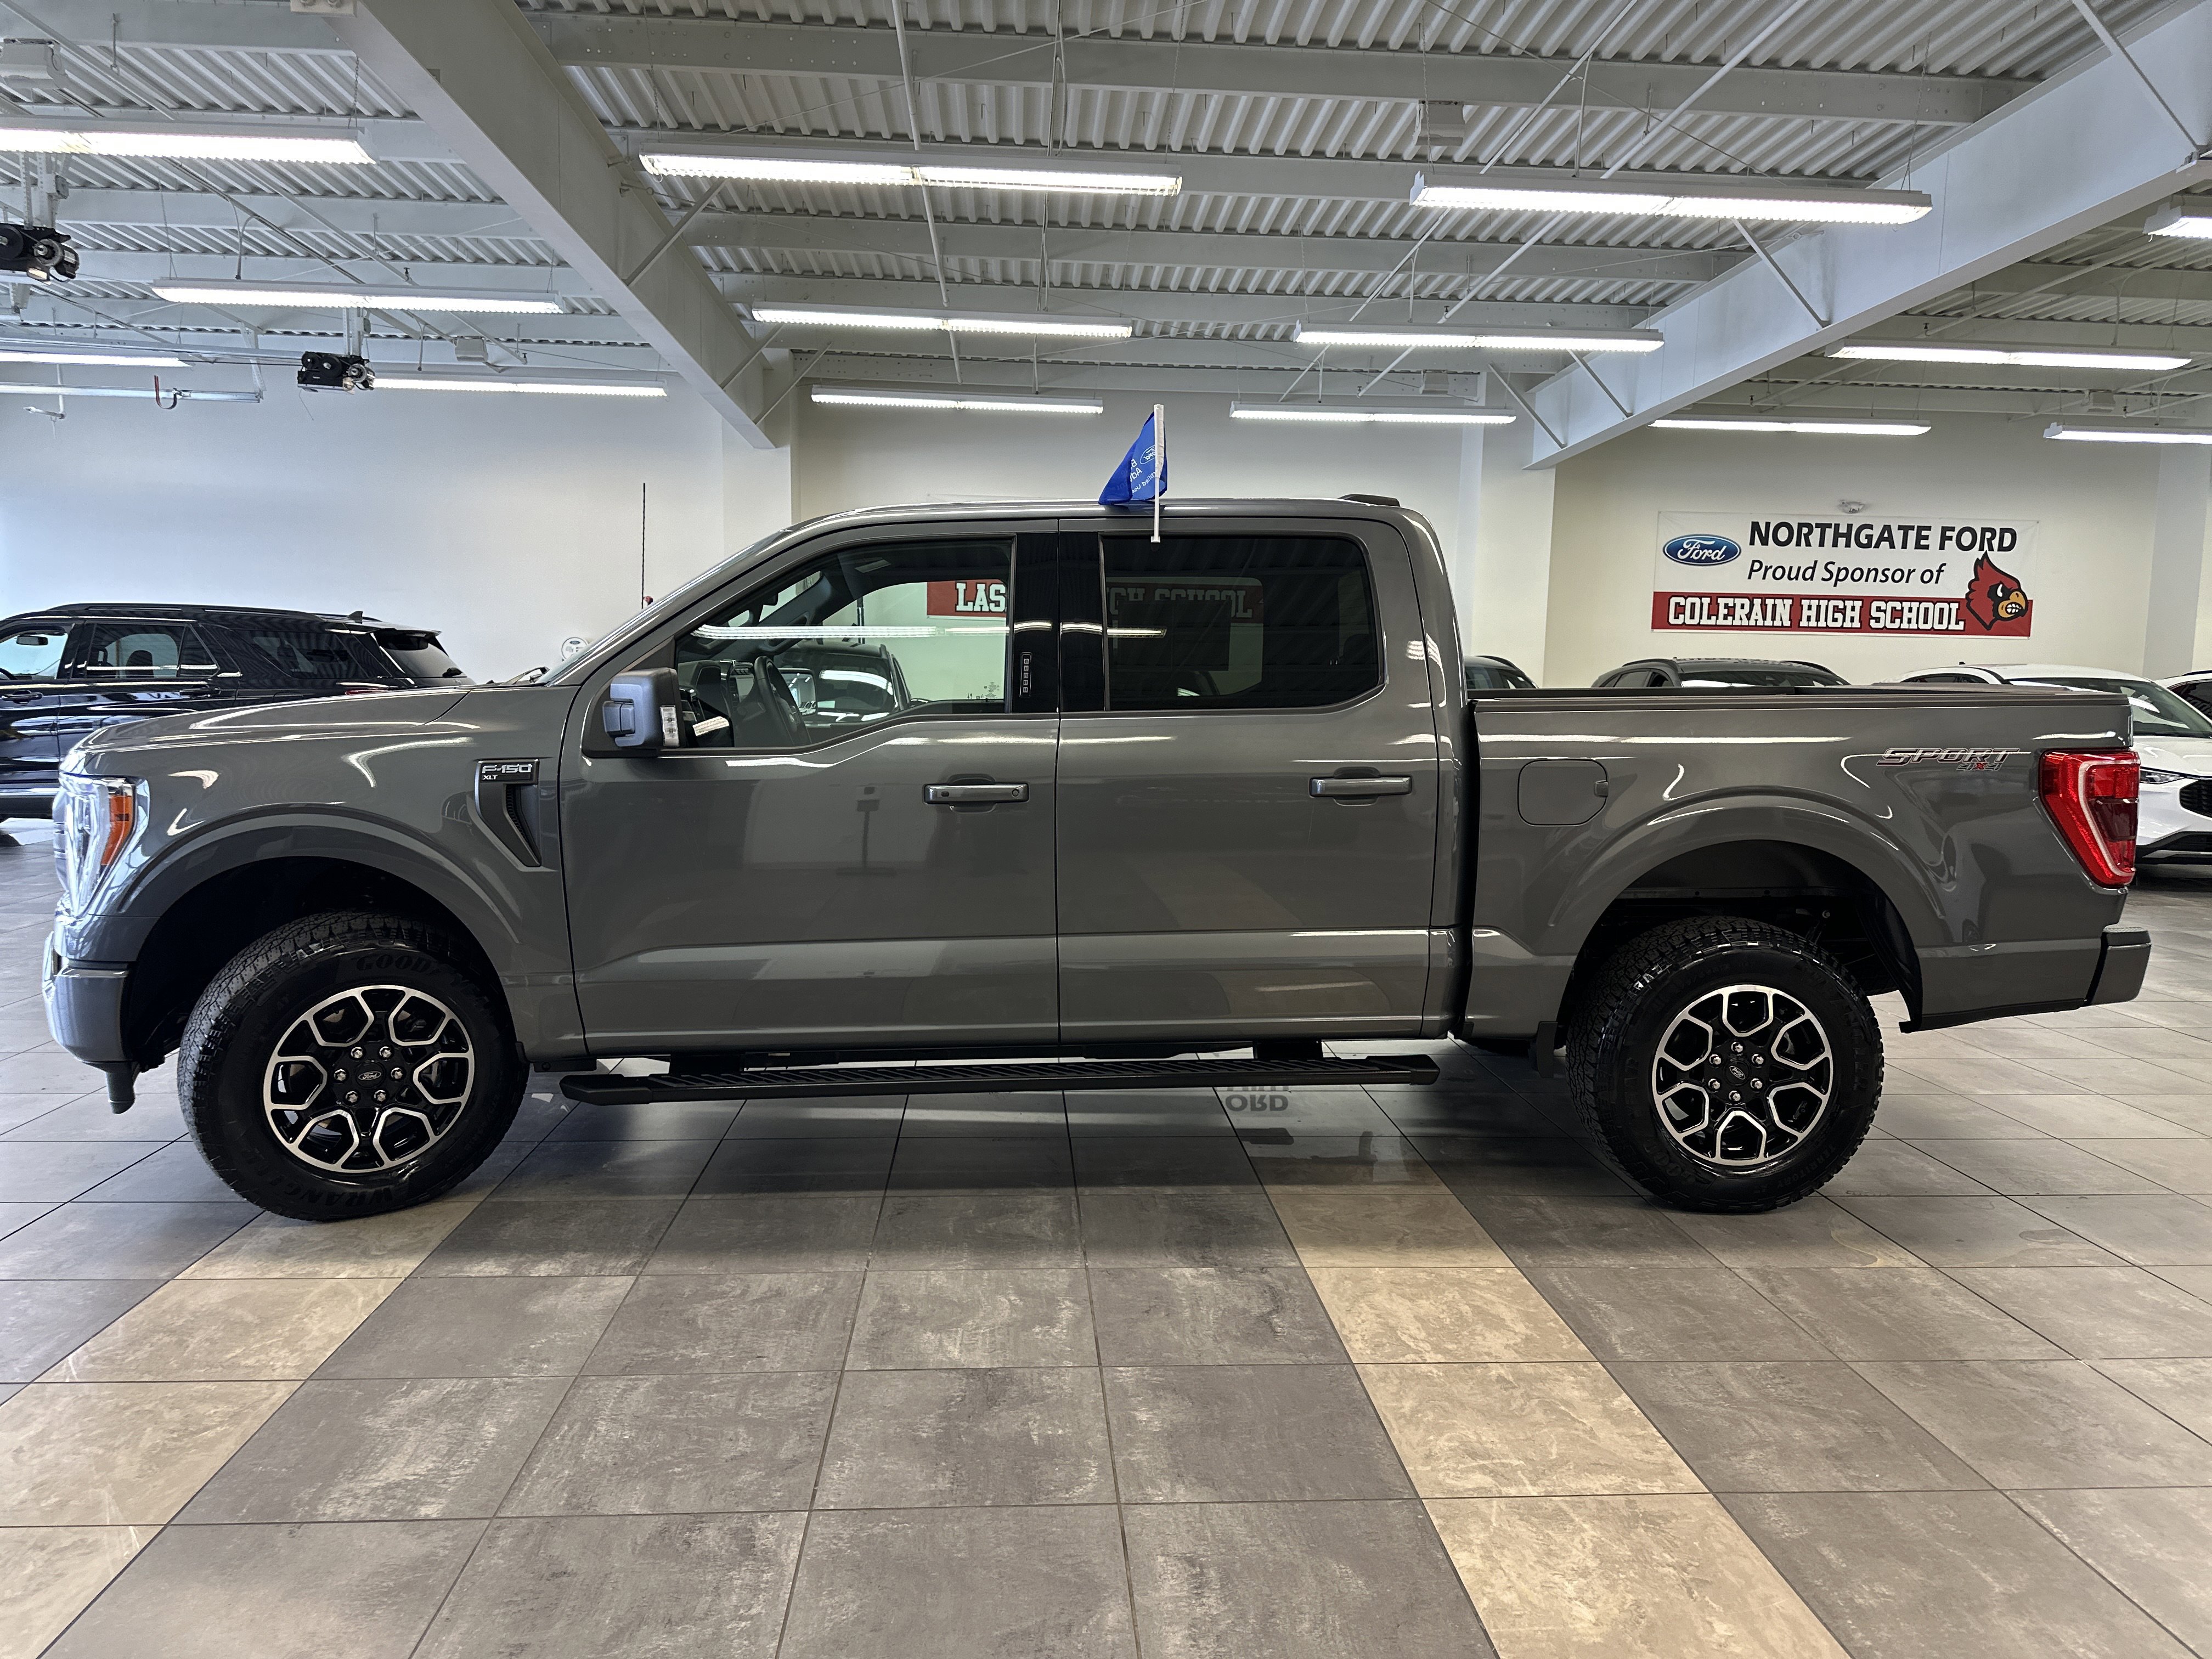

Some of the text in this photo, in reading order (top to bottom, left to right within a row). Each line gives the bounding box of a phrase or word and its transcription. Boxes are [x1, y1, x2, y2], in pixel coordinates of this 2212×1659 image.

[1677, 537, 1726, 562] Ford
[1749, 521, 2017, 552] NORTHGATE FORD
[1747, 559, 1947, 587] Proud Sponsor of
[956, 583, 1006, 612] LAS
[1668, 597, 1966, 630] COLERAIN HIGH SCHOOL
[482, 764, 533, 774] F-150
[1876, 748, 2020, 766] SPORT
